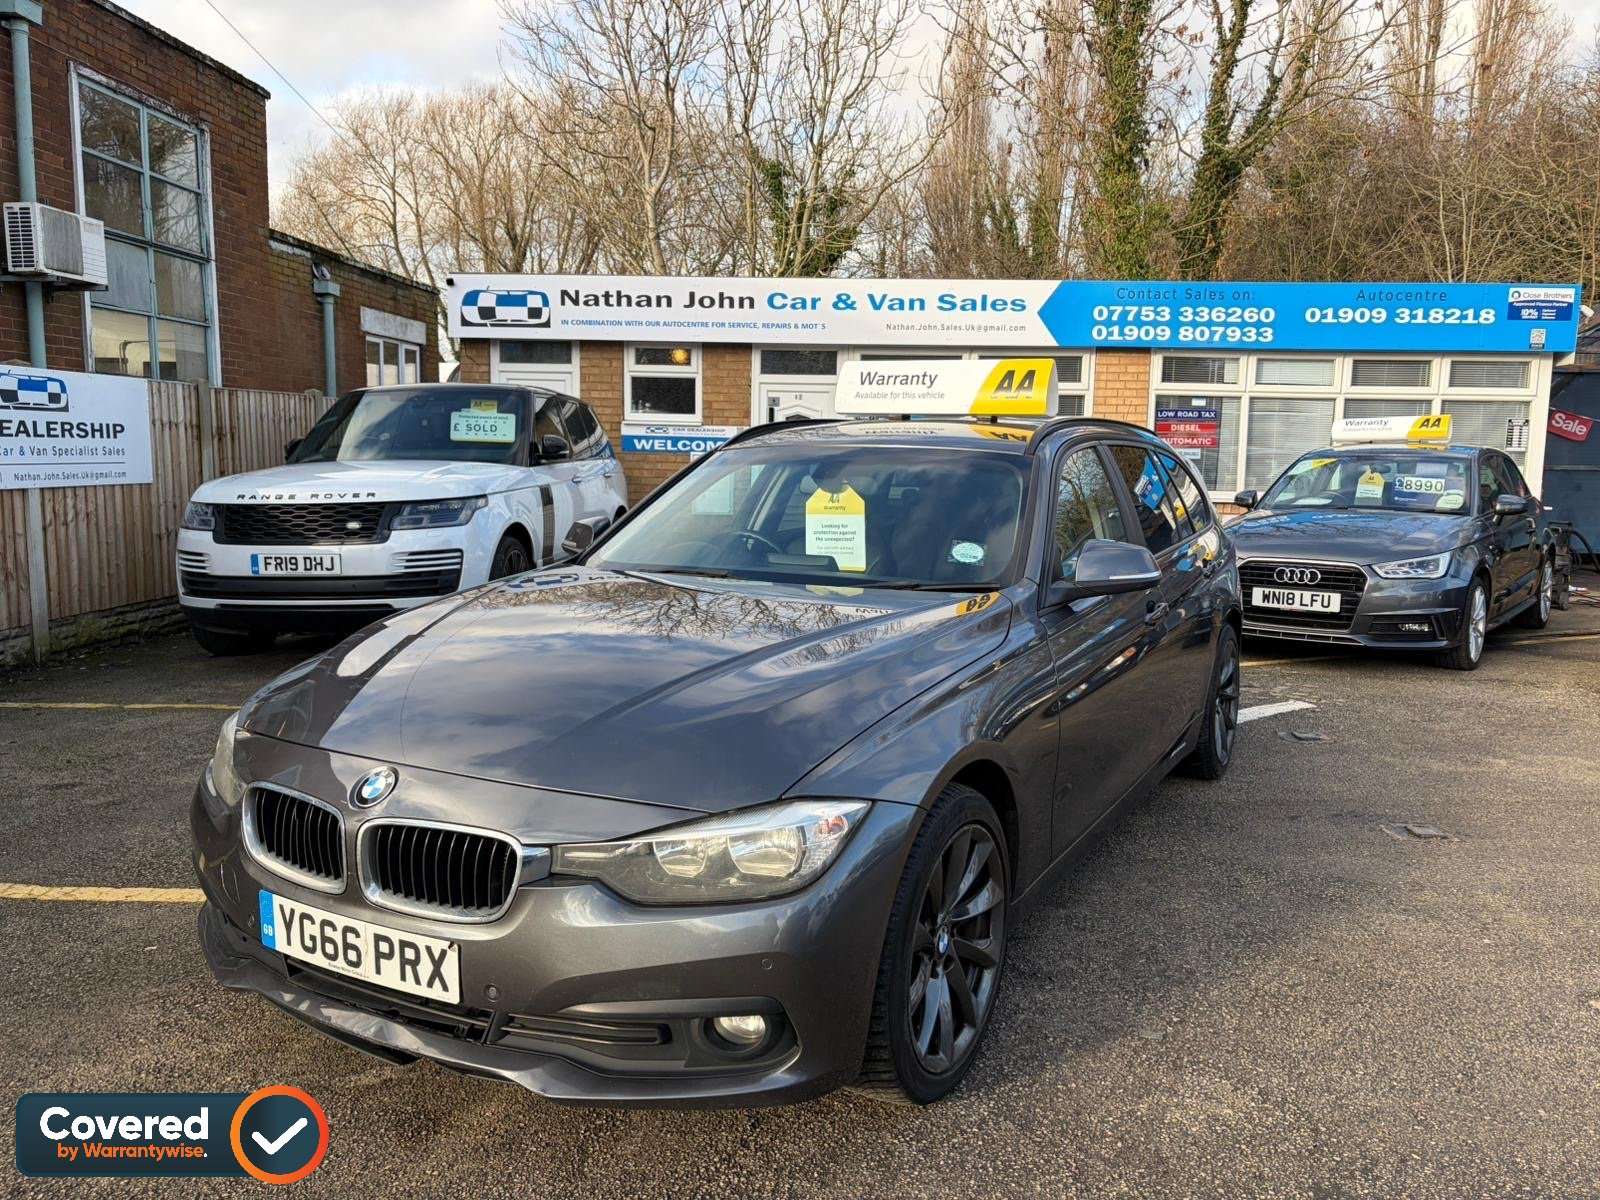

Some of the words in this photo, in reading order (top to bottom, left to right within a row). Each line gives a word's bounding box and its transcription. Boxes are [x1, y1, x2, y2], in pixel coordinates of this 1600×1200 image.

[560, 289, 673, 308] Nathan
[683, 290, 755, 309] John
[767, 292, 822, 312] Car
[832, 292, 857, 312] &
[868, 294, 926, 312] Van
[937, 294, 1026, 312] Sales
[1116, 288, 1177, 300] Contact
[1184, 288, 1224, 300] Sales
[1232, 290, 1256, 300] on:
[1356, 288, 1448, 301] Autocentre
[1092, 306, 1171, 321] 07753
[1178, 307, 1276, 323] 336260
[1304, 308, 1387, 324] 01909
[1394, 308, 1496, 324] 318218
[1091, 325, 1171, 341] 01909
[1178, 326, 1274, 342] 807933
[860, 371, 938, 389] Warranty
[994, 370, 1036, 394] AA
[890, 392, 900, 400] for
[0, 420, 126, 439] EALERSHIP
[466, 423, 498, 432] SOLD
[1418, 418, 1442, 428] AA
[1551, 412, 1586, 435] Sale
[20, 446, 26, 456] &
[29, 446, 48, 456] Van
[52, 446, 98, 458] Specialist
[102, 446, 126, 456] Sales
[634, 439, 725, 451] WELCOM
[264, 556, 298, 571] FR19
[303, 556, 334, 571] DHJ
[1261, 590, 1295, 606] WN18
[1299, 592, 1331, 608] LFU
[263, 924, 273, 936] GB
[279, 904, 362, 968] YG66
[373, 932, 450, 992] PRX
